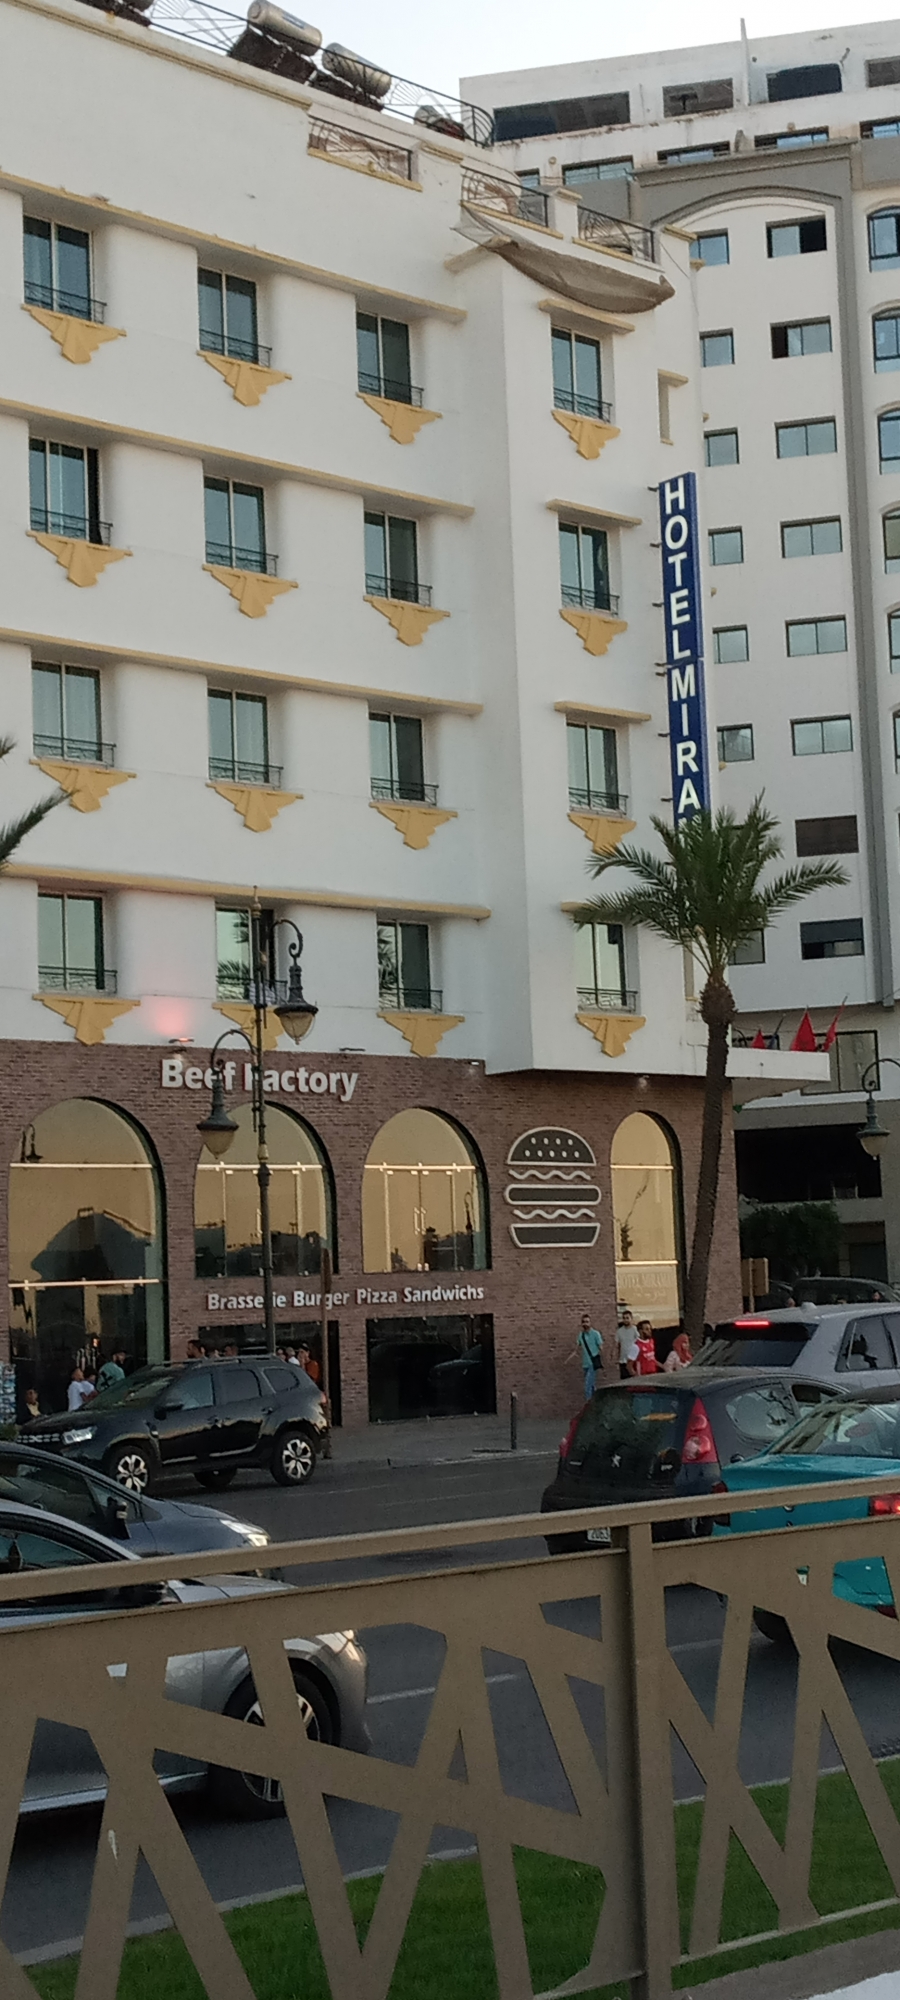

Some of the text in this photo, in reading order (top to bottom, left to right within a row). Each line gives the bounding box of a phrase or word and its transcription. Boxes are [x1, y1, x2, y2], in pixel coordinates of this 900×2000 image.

[664, 477, 691, 660] HOTEL
[161, 1059, 236, 1091] Beef
[207, 1285, 485, 1310] Brasseie Burger Pizza Sandwichs
